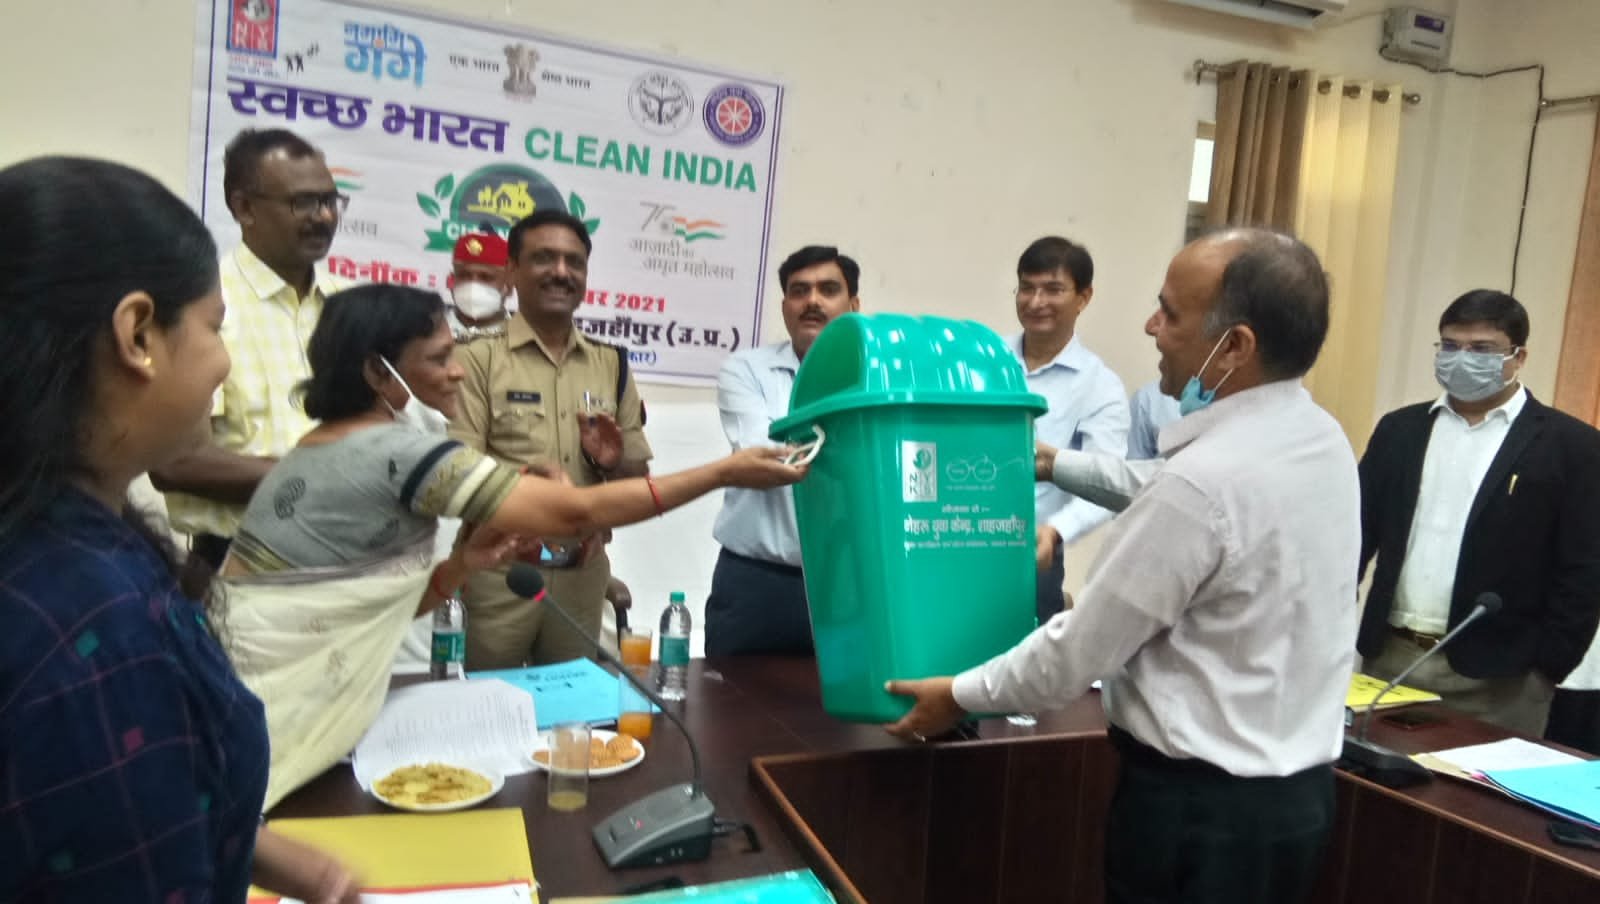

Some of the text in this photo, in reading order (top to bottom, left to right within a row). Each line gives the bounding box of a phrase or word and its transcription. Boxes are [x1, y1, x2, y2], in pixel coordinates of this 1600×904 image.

[227, 76, 510, 153] स्वच्छ भारत
[524, 127, 757, 192] CLEAN INDIA
[614, 293, 666, 313] 2021
